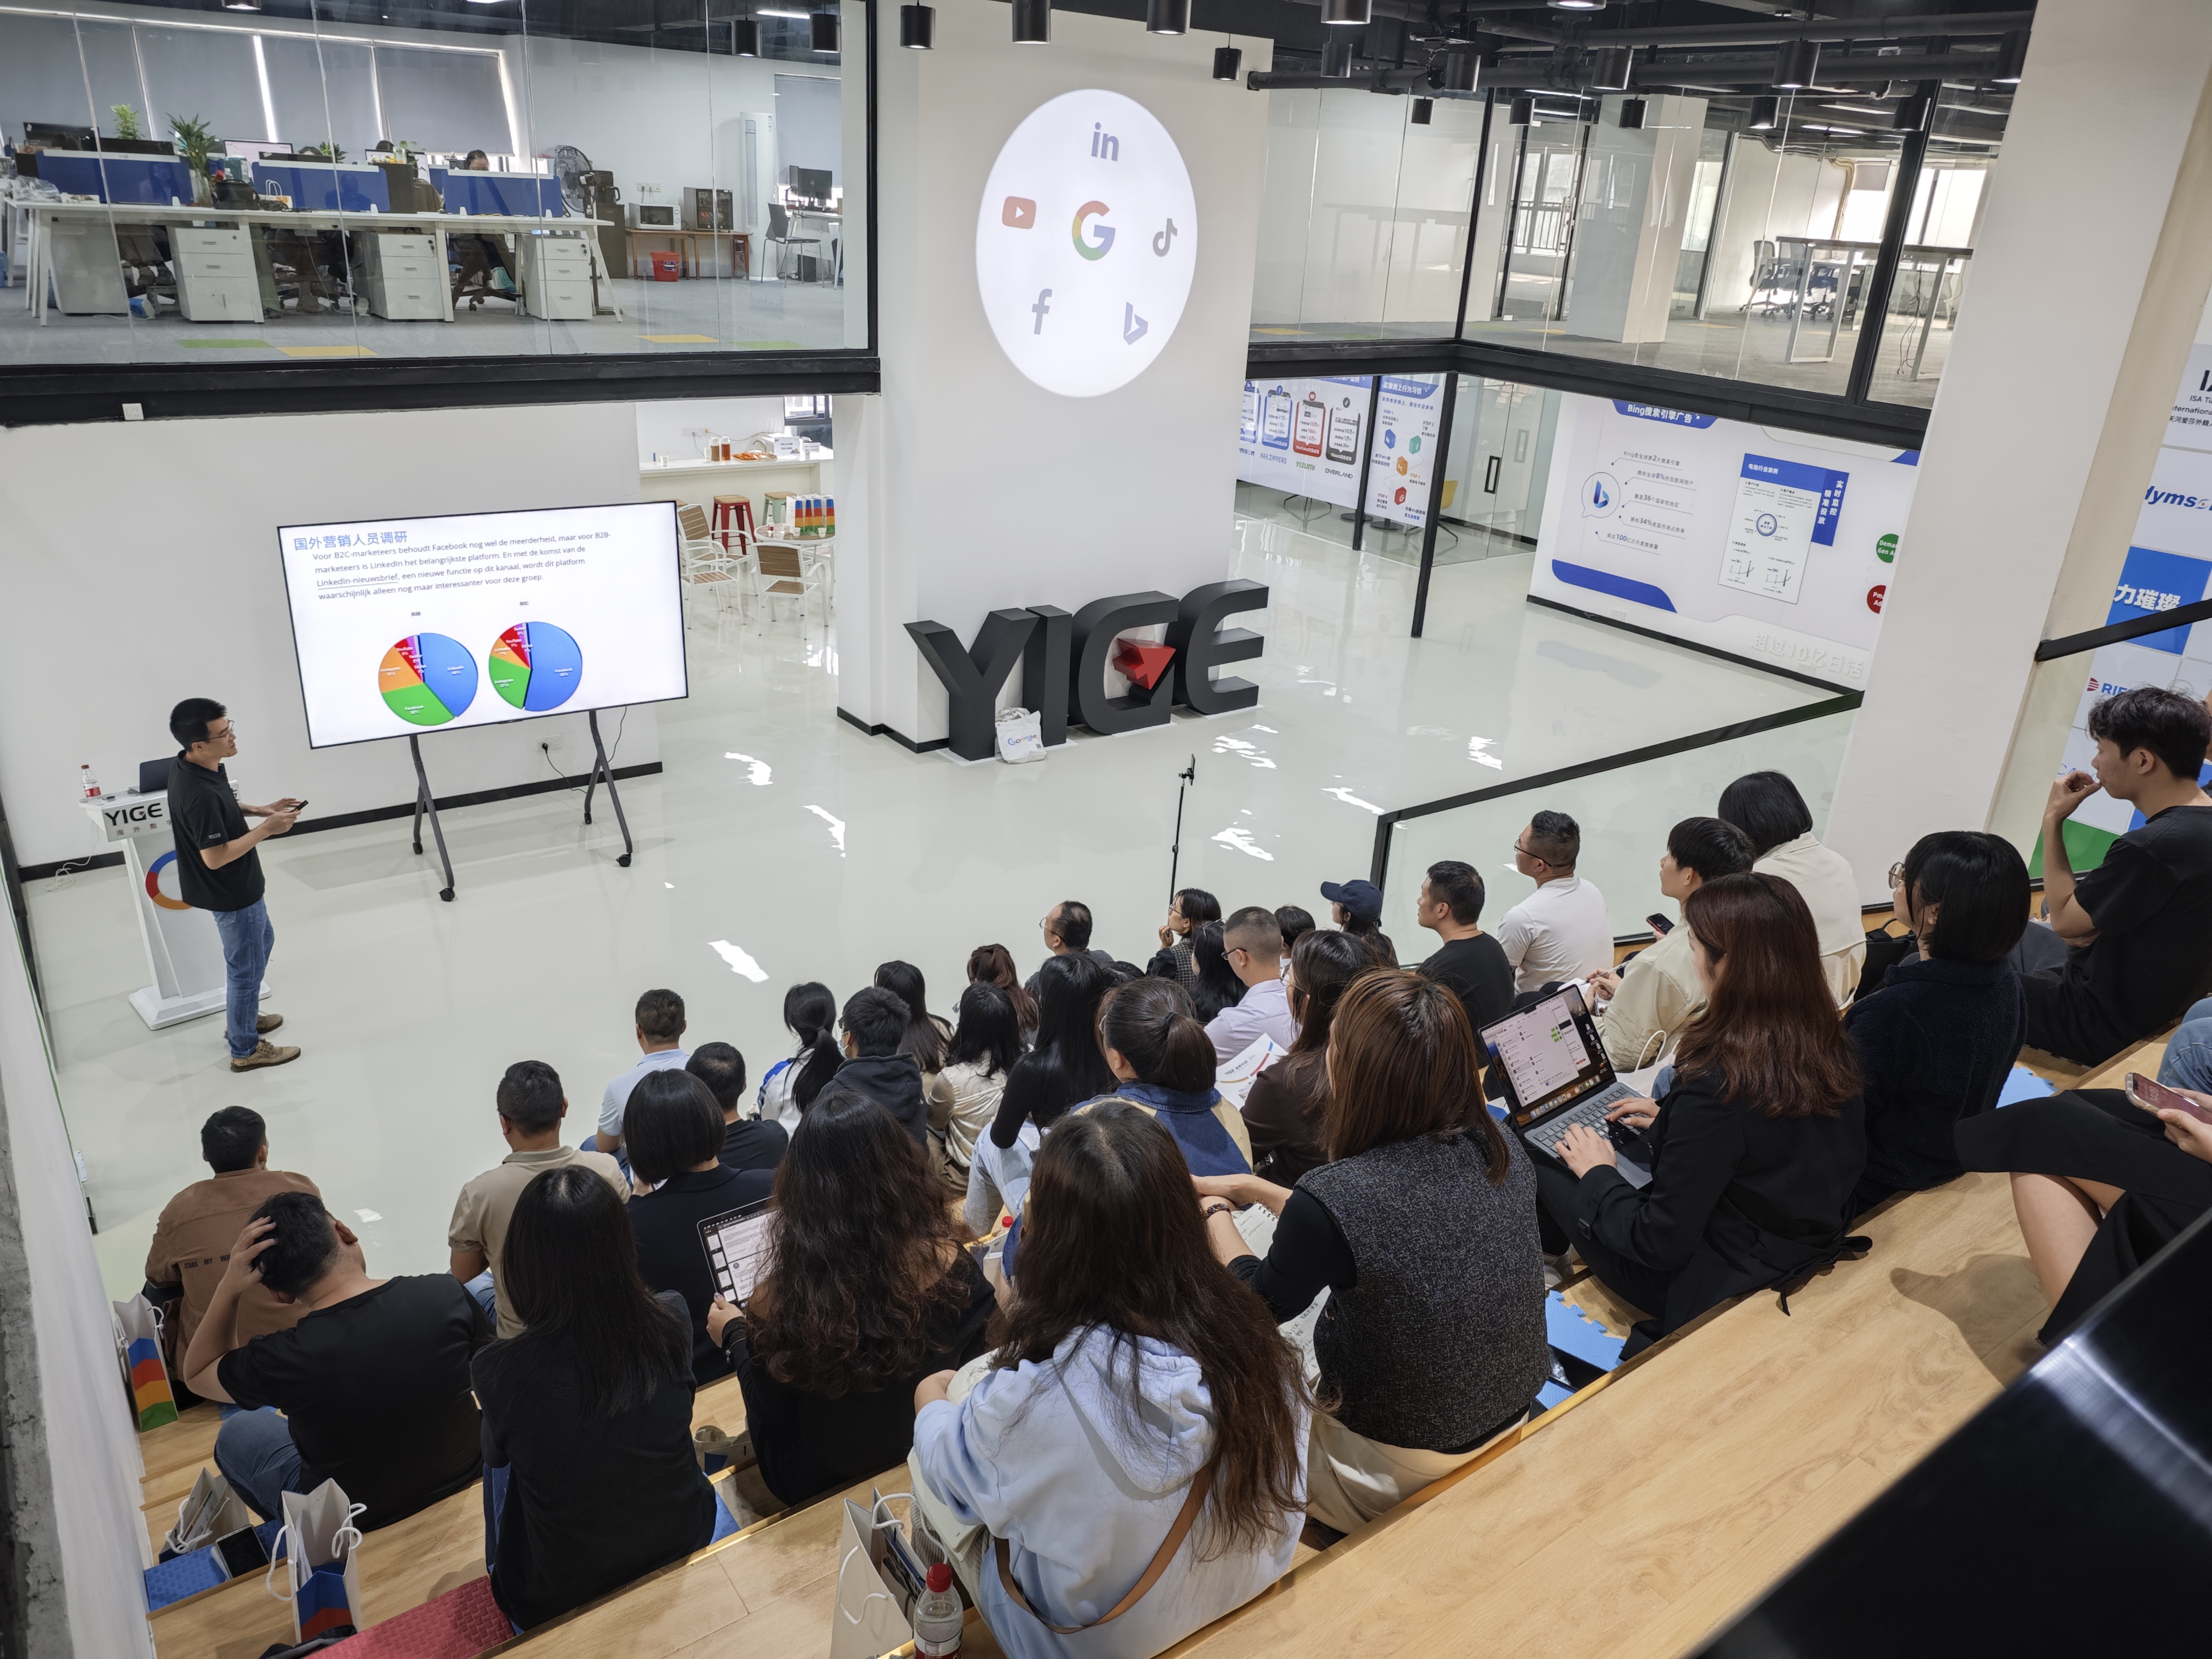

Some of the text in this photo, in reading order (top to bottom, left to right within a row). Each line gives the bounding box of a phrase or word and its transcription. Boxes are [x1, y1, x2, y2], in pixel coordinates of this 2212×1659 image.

[1091, 122, 1119, 161] in
[1627, 404, 1692, 424] Bing搜索引擎广告
[2172, 405, 2212, 415] nternationa
[1296, 461, 1316, 471] YIZUMI
[1623, 451, 1680, 466] Bing是全球第2大搜索引擎
[1325, 468, 1353, 478] OVERLAND
[1748, 463, 1779, 475] 电池行业案例
[1637, 470, 1694, 486] 拥有全球8%的互联网用户
[1634, 494, 1680, 508] 覆盖36个国家和地区
[1630, 517, 1685, 534] 拥有34%美国市场占有率
[294, 531, 408, 551] 国外营销人员调研
[334, 548, 396, 559] B2C-marketeers
[399, 545, 430, 554] behoudt
[433, 542, 467, 551] Facebook
[510, 536, 557, 545] meerderheid,
[1607, 533, 1658, 550] 高达100亿次月度搜索量
[315, 563, 360, 574] marketeers
[370, 560, 403, 569] LinkedIn
[419, 555, 466, 565] belangrijkste
[468, 552, 501, 562] platform.
[418, 569, 444, 578] nieuwe
[447, 568, 471, 576] functie
[523, 561, 544, 569] wordt
[556, 558, 585, 568] platform
[319, 589, 371, 600] waarschijnlijk
[435, 580, 483, 589] interessanter
[522, 575, 544, 583] groep.
[903, 578, 1269, 762] YIGE
[1008, 734, 1037, 745] Google
[104, 802, 163, 826] YIGE
[184, 1261, 198, 1269] STARS
